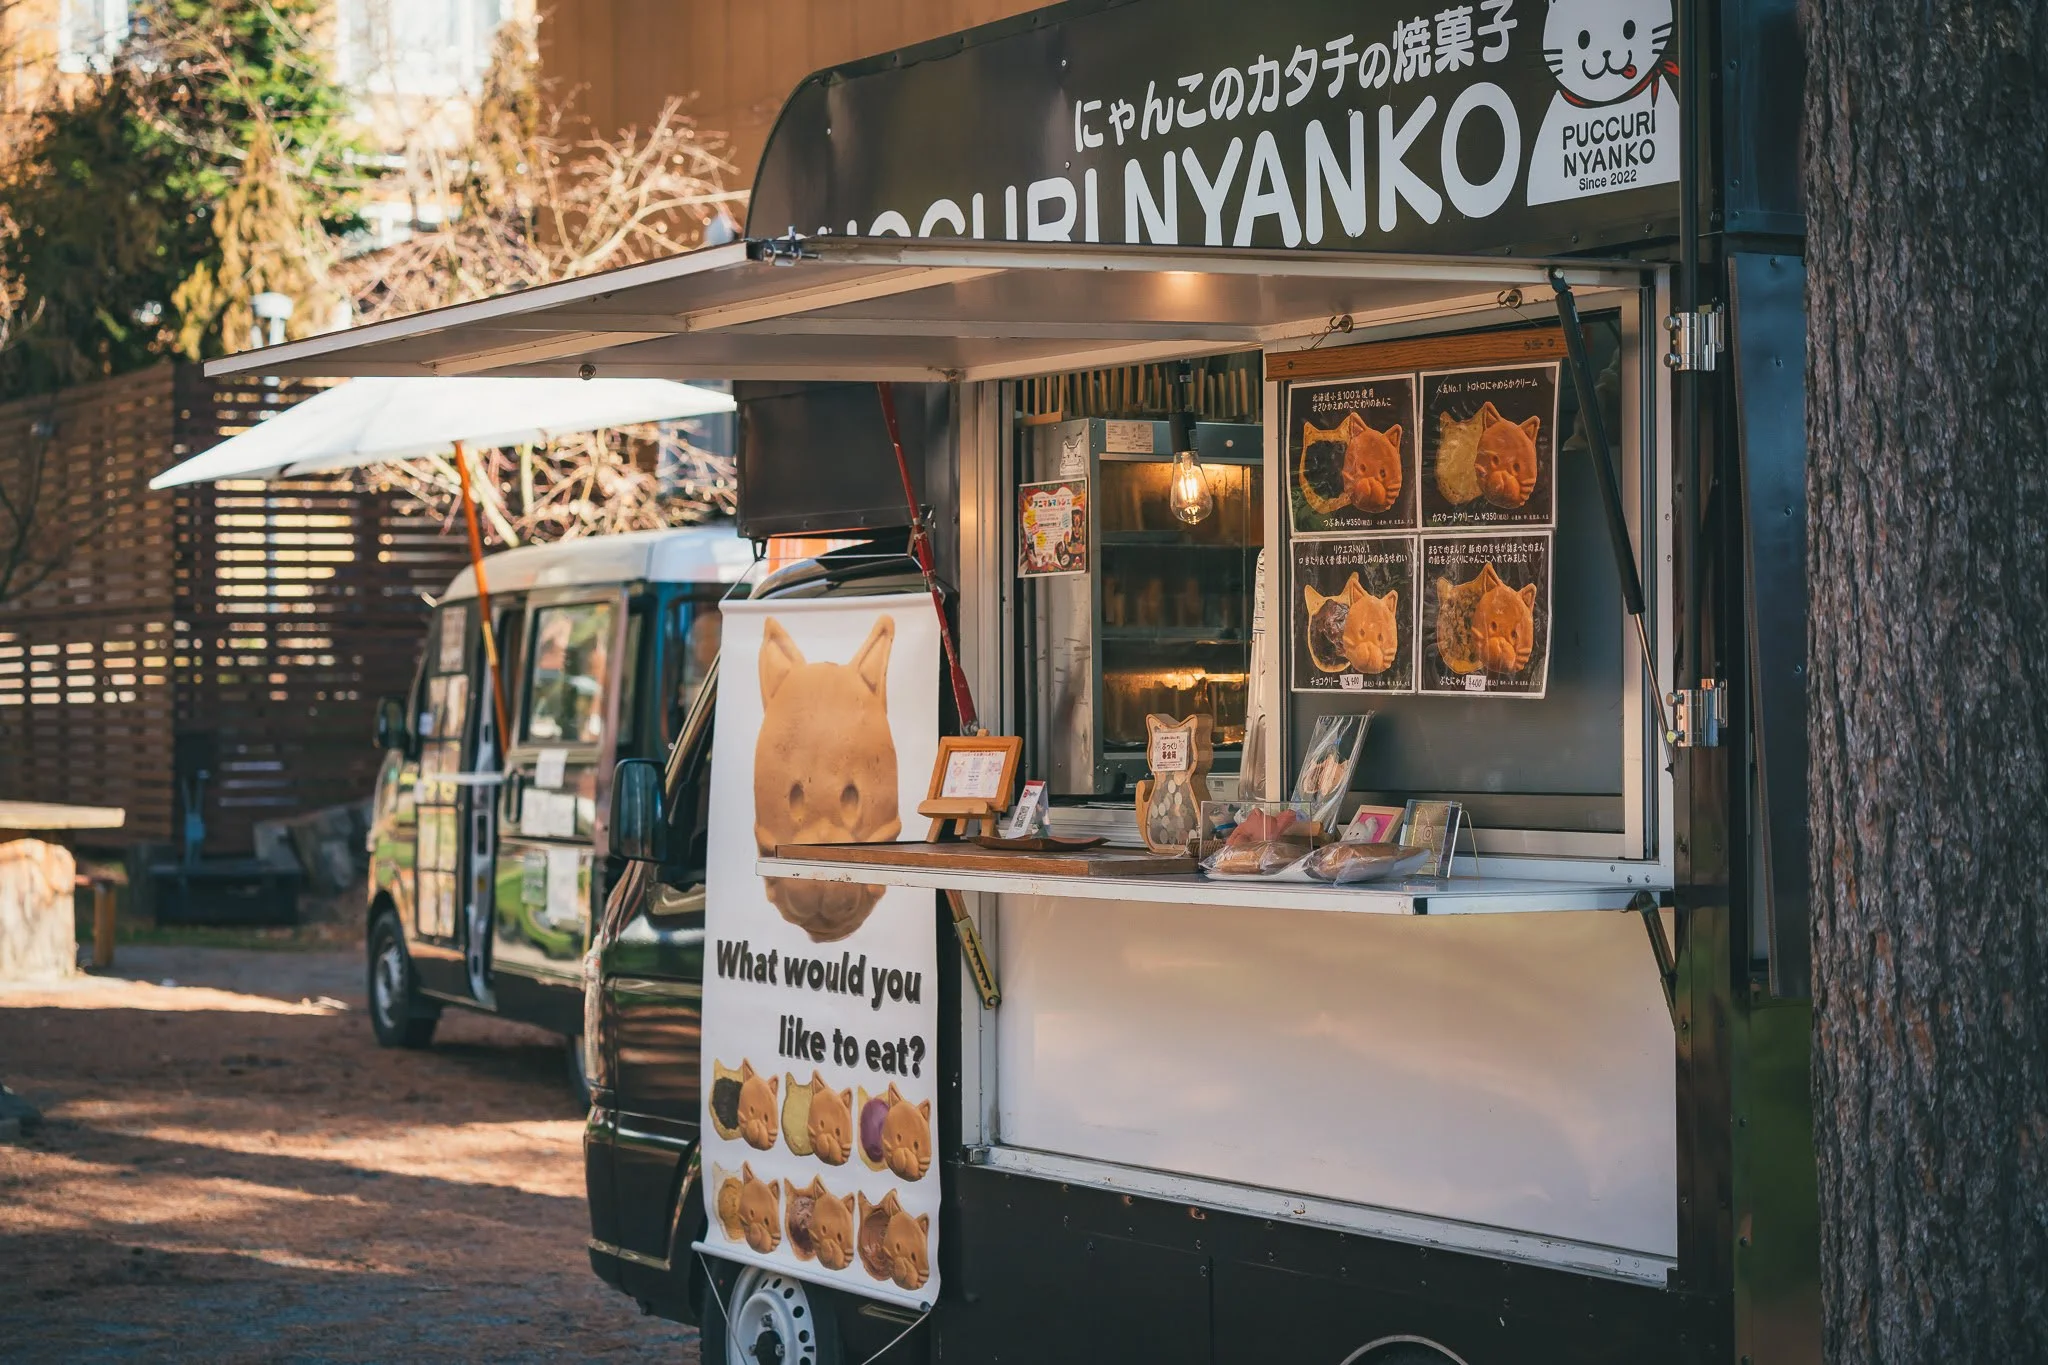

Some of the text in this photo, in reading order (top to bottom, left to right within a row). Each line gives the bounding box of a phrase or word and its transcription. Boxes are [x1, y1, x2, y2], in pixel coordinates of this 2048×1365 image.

[1074, 0, 1517, 152] にゃんこのカタチの焼菓子
[1562, 109, 1656, 150] PUCCURI
[1124, 81, 1521, 248] NYANKO
[1563, 138, 1656, 178] NYANKO
[1578, 169, 1637, 191] Since 2022
[1432, 512, 1480, 523] カスタードクリーム
[1310, 676, 1341, 687] チョコクリー
[717, 940, 922, 1011] What would you
[778, 1014, 926, 1079] like to eat?
